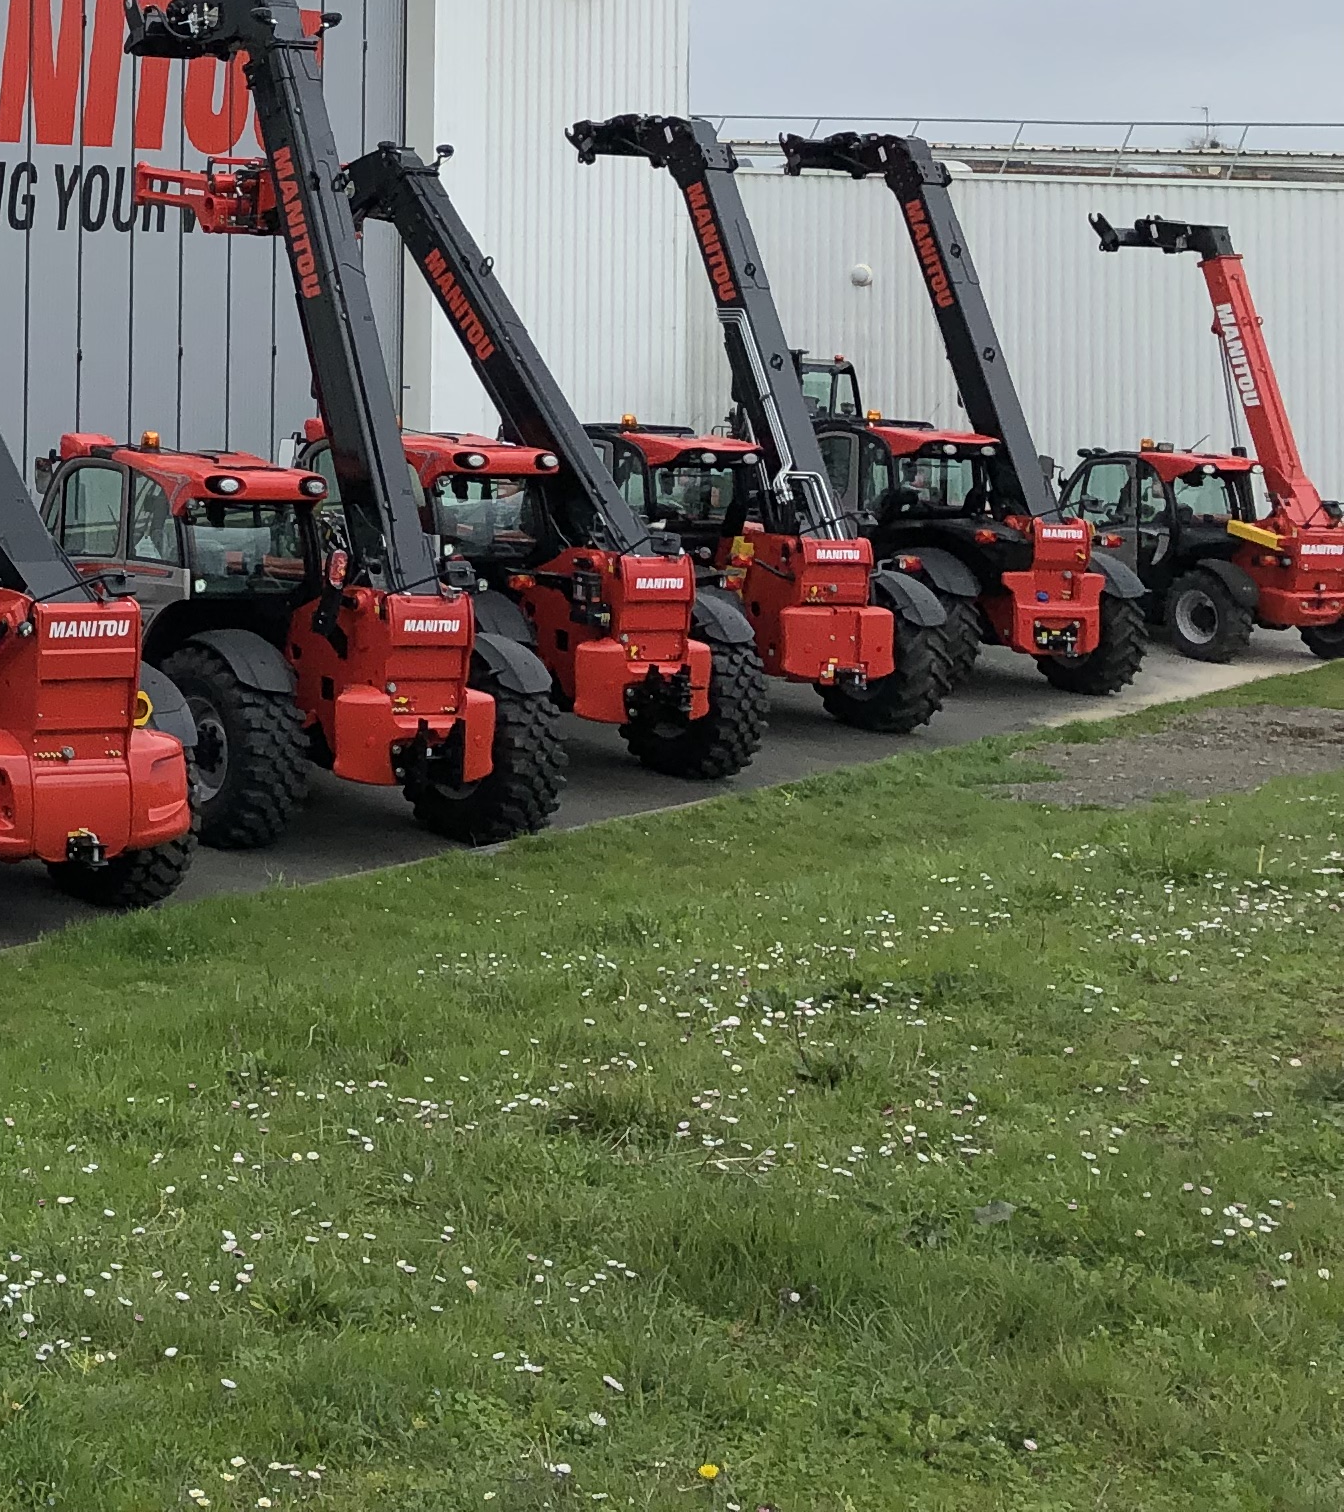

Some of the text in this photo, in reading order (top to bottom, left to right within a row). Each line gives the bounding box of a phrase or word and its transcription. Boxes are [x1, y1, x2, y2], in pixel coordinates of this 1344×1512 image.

[273, 145, 321, 299] MANITOU
[687, 181, 737, 302] MANITOU
[905, 198, 954, 308] MANITOU
[424, 247, 495, 361] MANITOU
[1215, 303, 1261, 407] MANITOU
[816, 549, 860, 560] MANITOU
[1042, 528, 1084, 539] MANITOU
[635, 577, 684, 590] MANITOU
[48, 619, 131, 639] MANITOU
[403, 619, 461, 633] MANITOU
